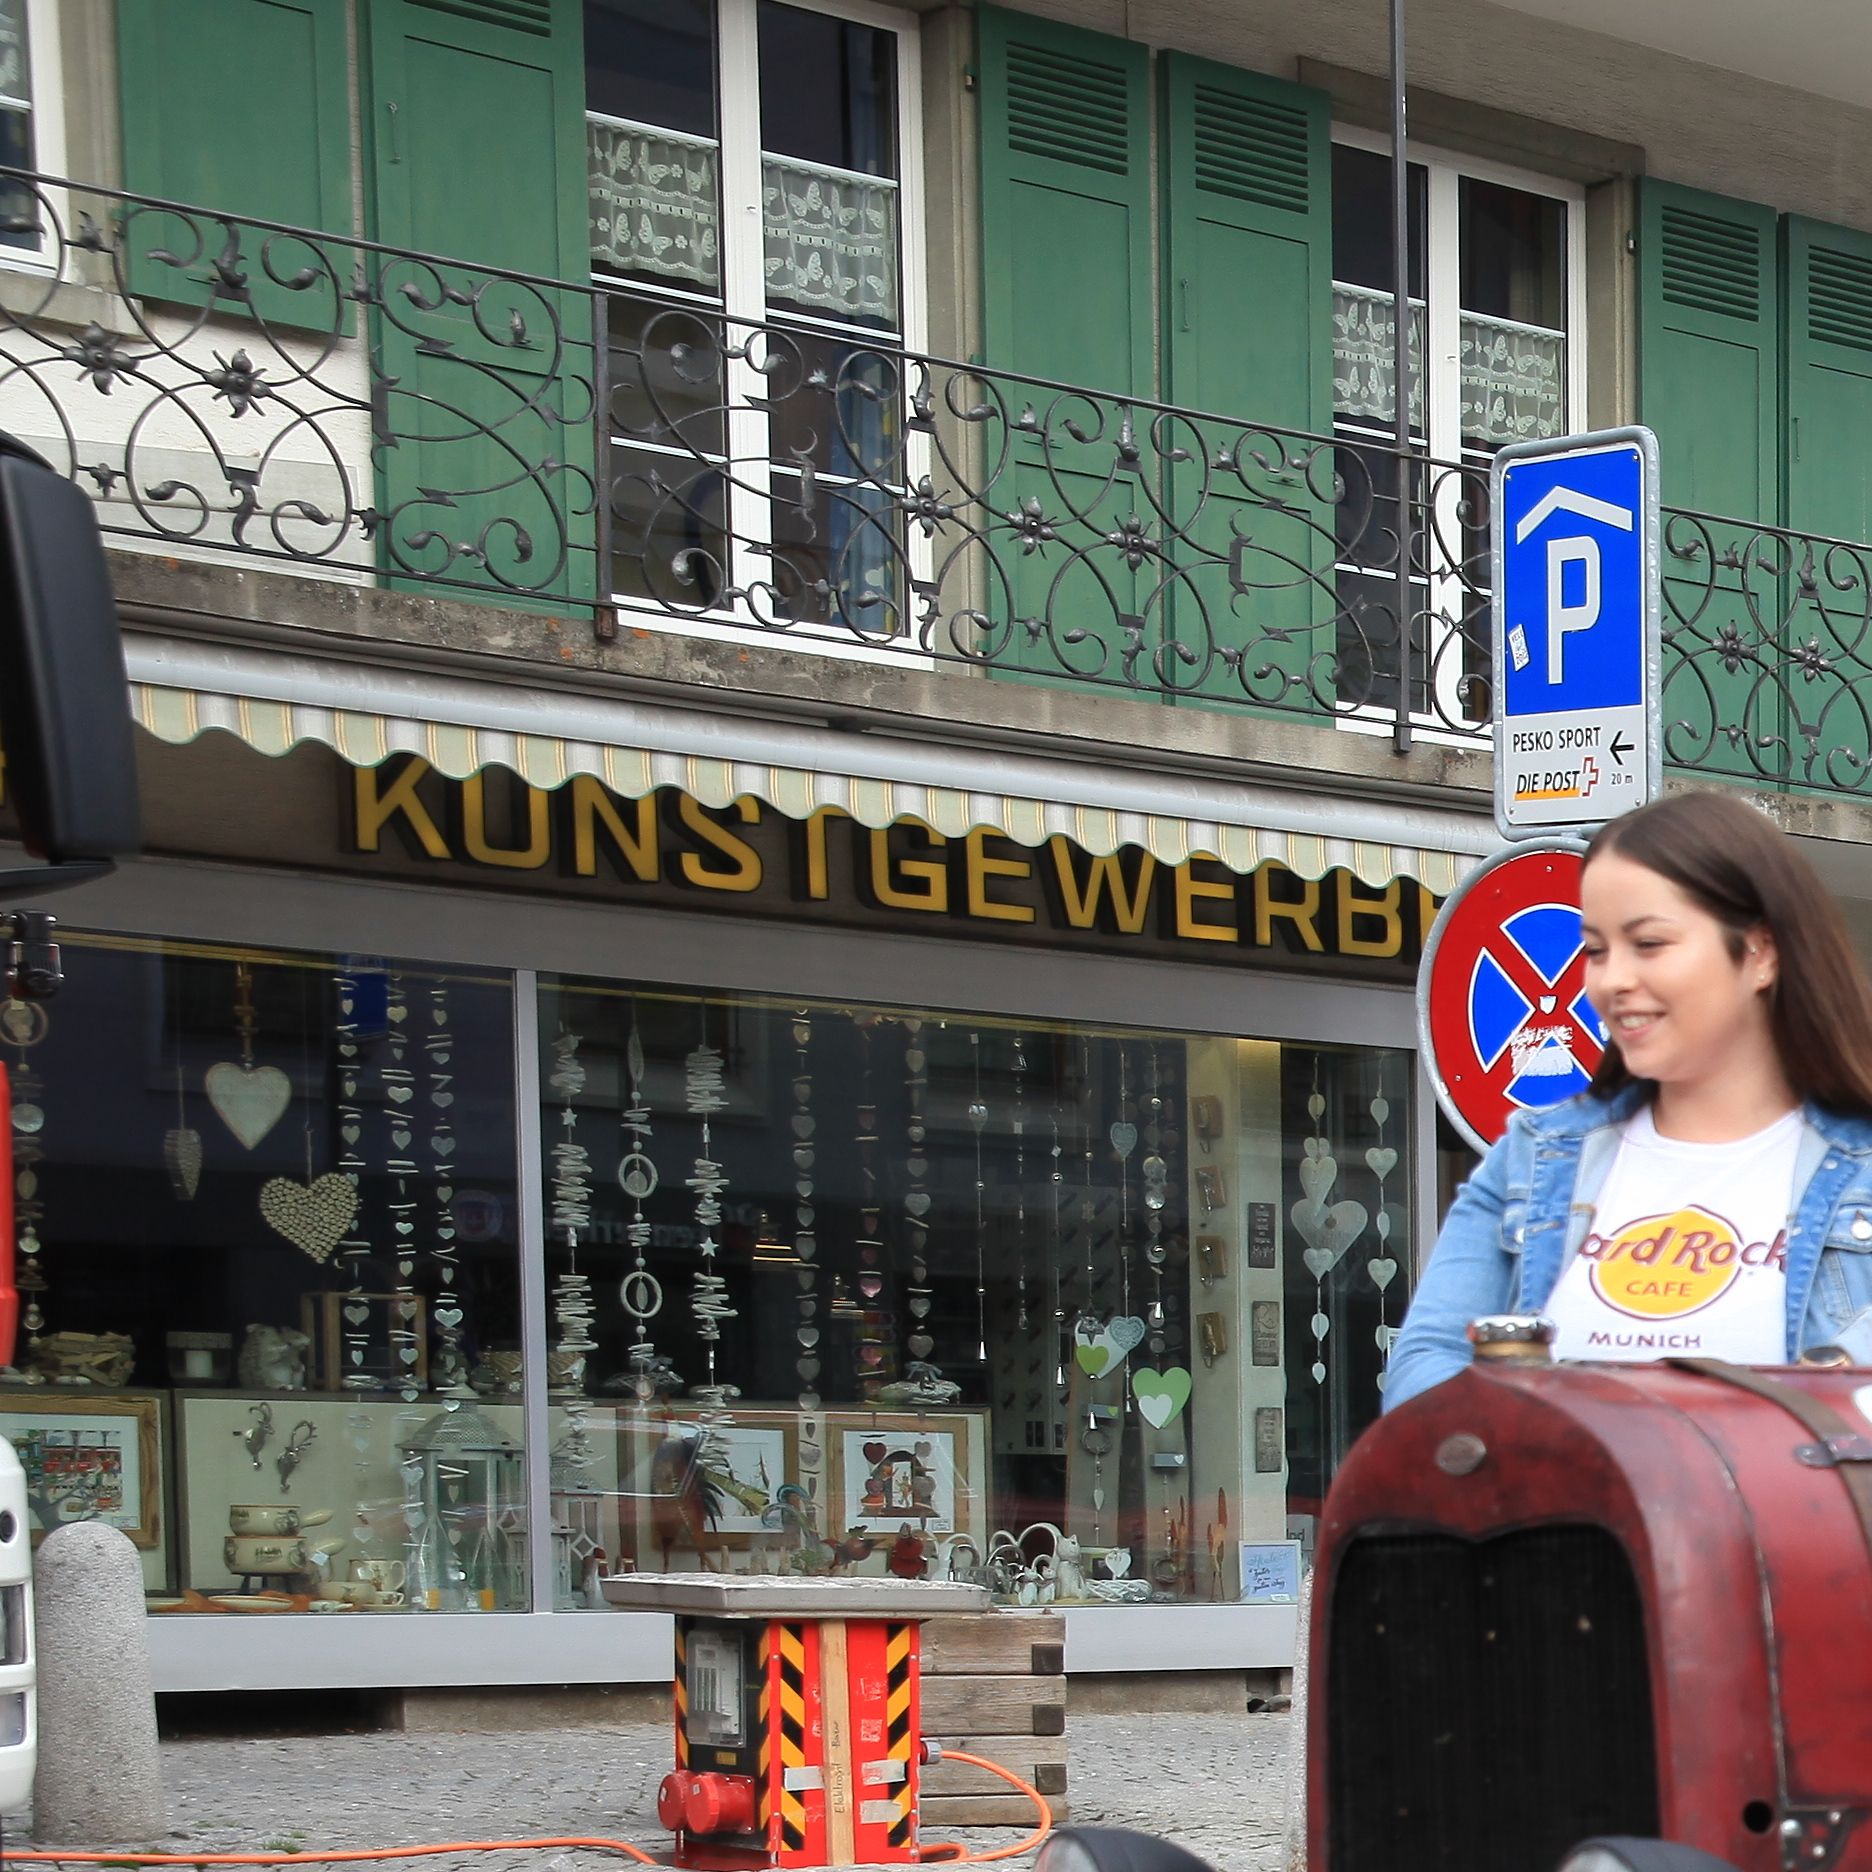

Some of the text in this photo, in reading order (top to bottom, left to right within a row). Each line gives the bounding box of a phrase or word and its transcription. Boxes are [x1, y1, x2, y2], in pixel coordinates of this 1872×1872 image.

[1547, 535, 1602, 685] P
[1512, 726, 1602, 753] PESKO SPORT
[1516, 770, 1581, 794] DIE POST
[1611, 773, 1634, 786] 20 m
[1671, 1228, 1788, 1275] Rock
[1626, 1280, 1694, 1298] CAFE
[1588, 1331, 1702, 1349] MUNICH
